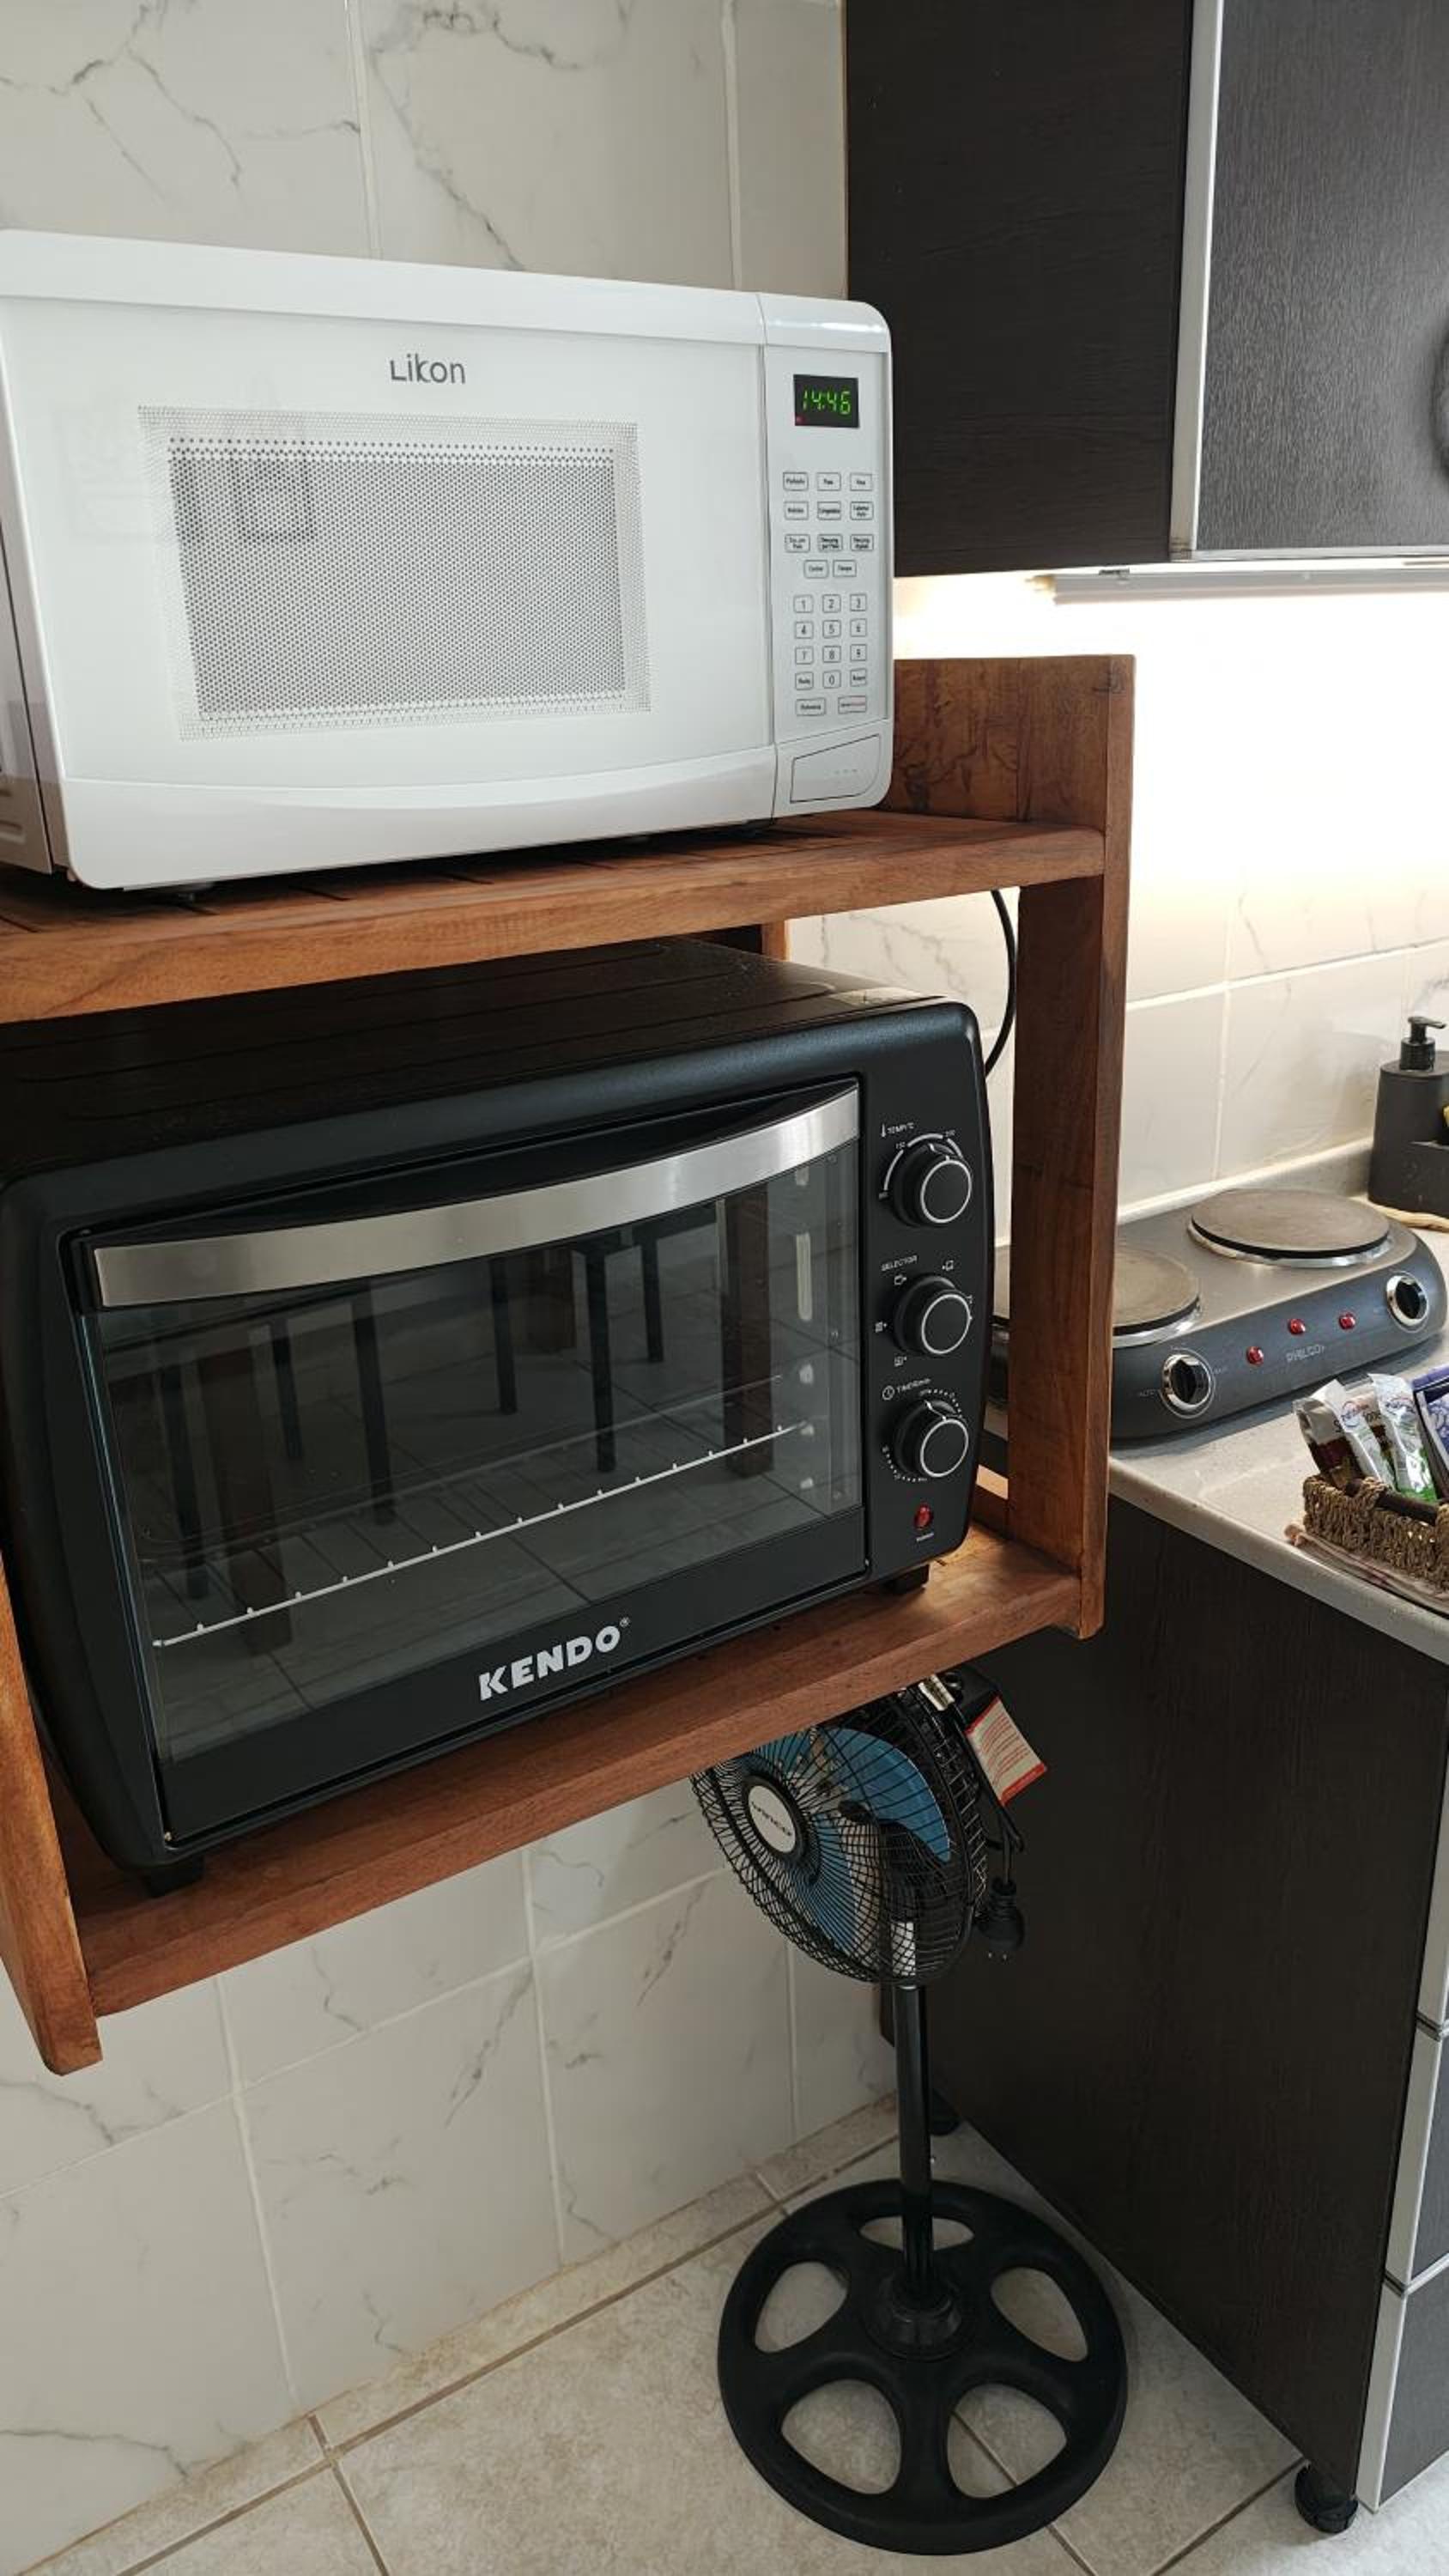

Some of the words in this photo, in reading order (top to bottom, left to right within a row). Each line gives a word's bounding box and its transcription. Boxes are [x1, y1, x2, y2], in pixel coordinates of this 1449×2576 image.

[390, 353, 466, 384] Likon
[802, 390, 852, 415] 14:46
[828, 623, 835, 635] 5
[828, 650, 835, 660] 8
[828, 674, 835, 685] 0
[881, 1255, 918, 1272] SELECTOR
[478, 1625, 621, 1701] KENDO
